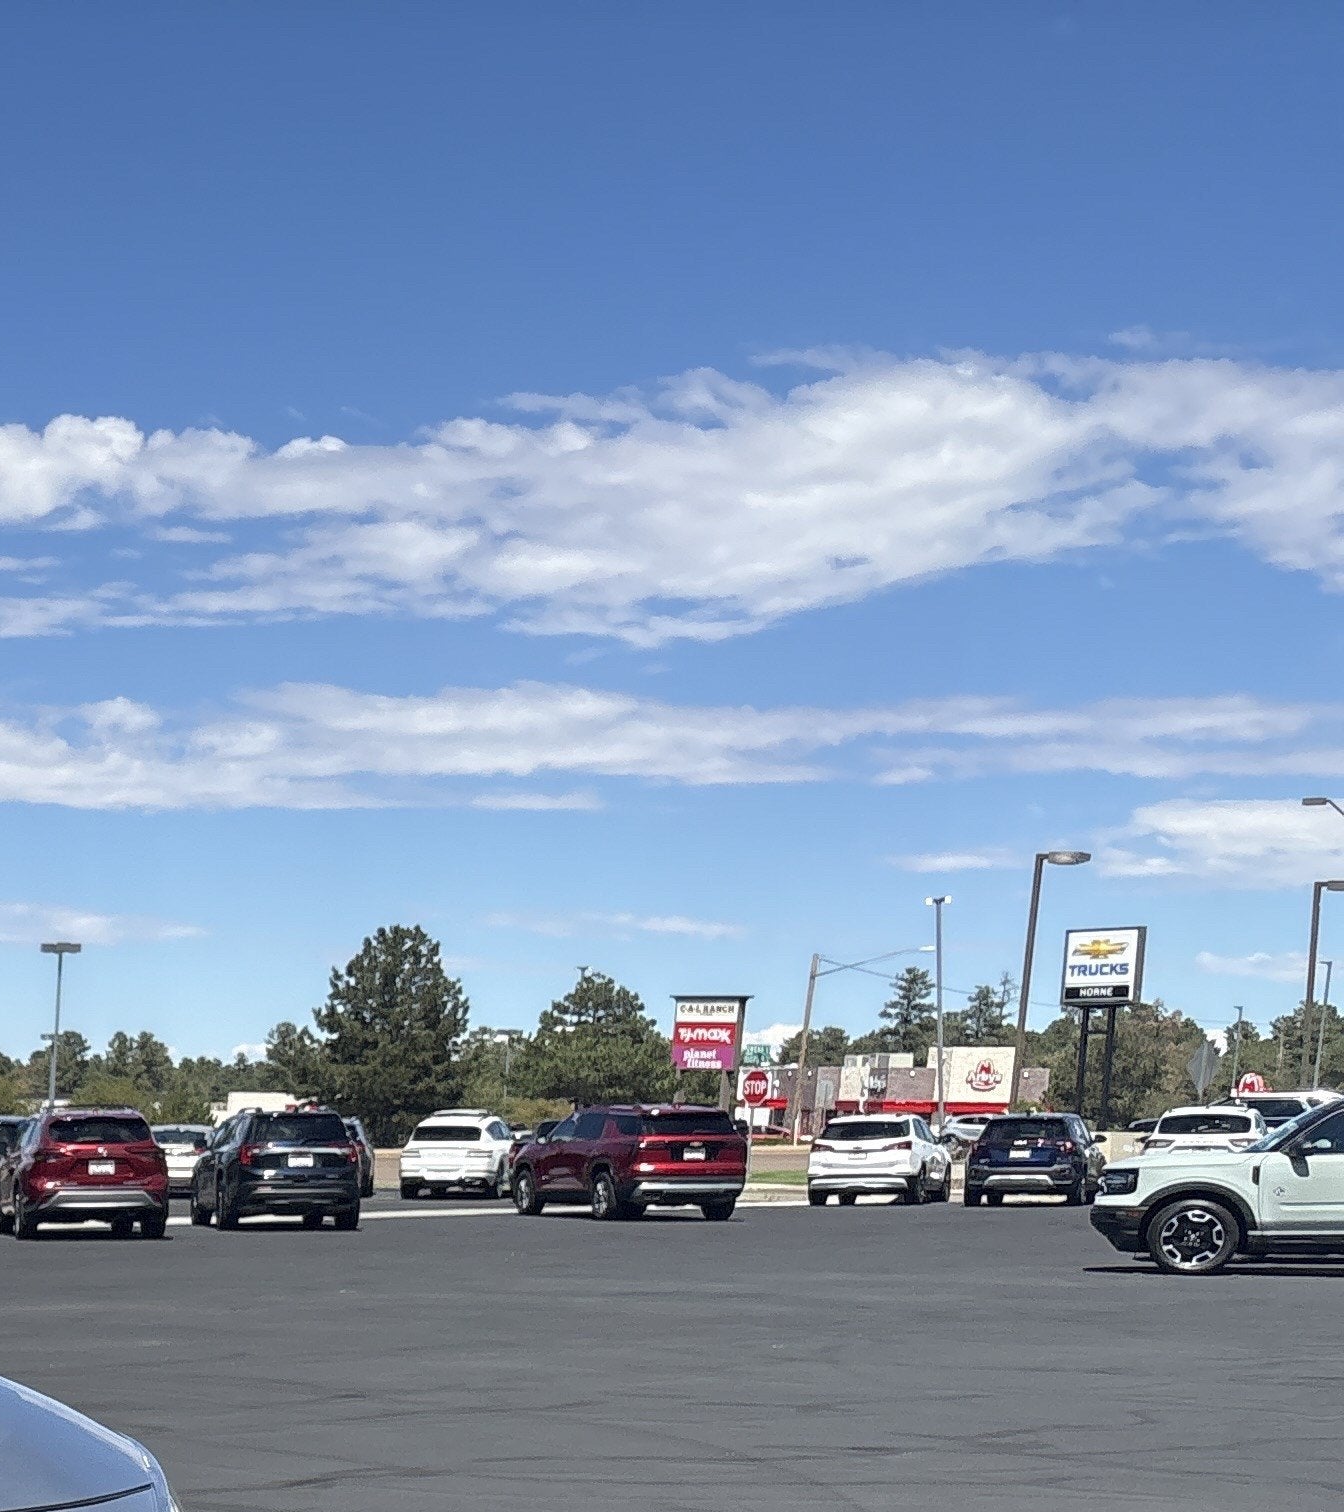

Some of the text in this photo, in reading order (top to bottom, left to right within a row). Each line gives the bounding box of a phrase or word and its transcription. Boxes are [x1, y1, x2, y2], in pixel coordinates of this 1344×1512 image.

[1069, 963, 1129, 977] TRUCKS
[683, 1048, 717, 1061] planet
[744, 1080, 767, 1095] STOP
